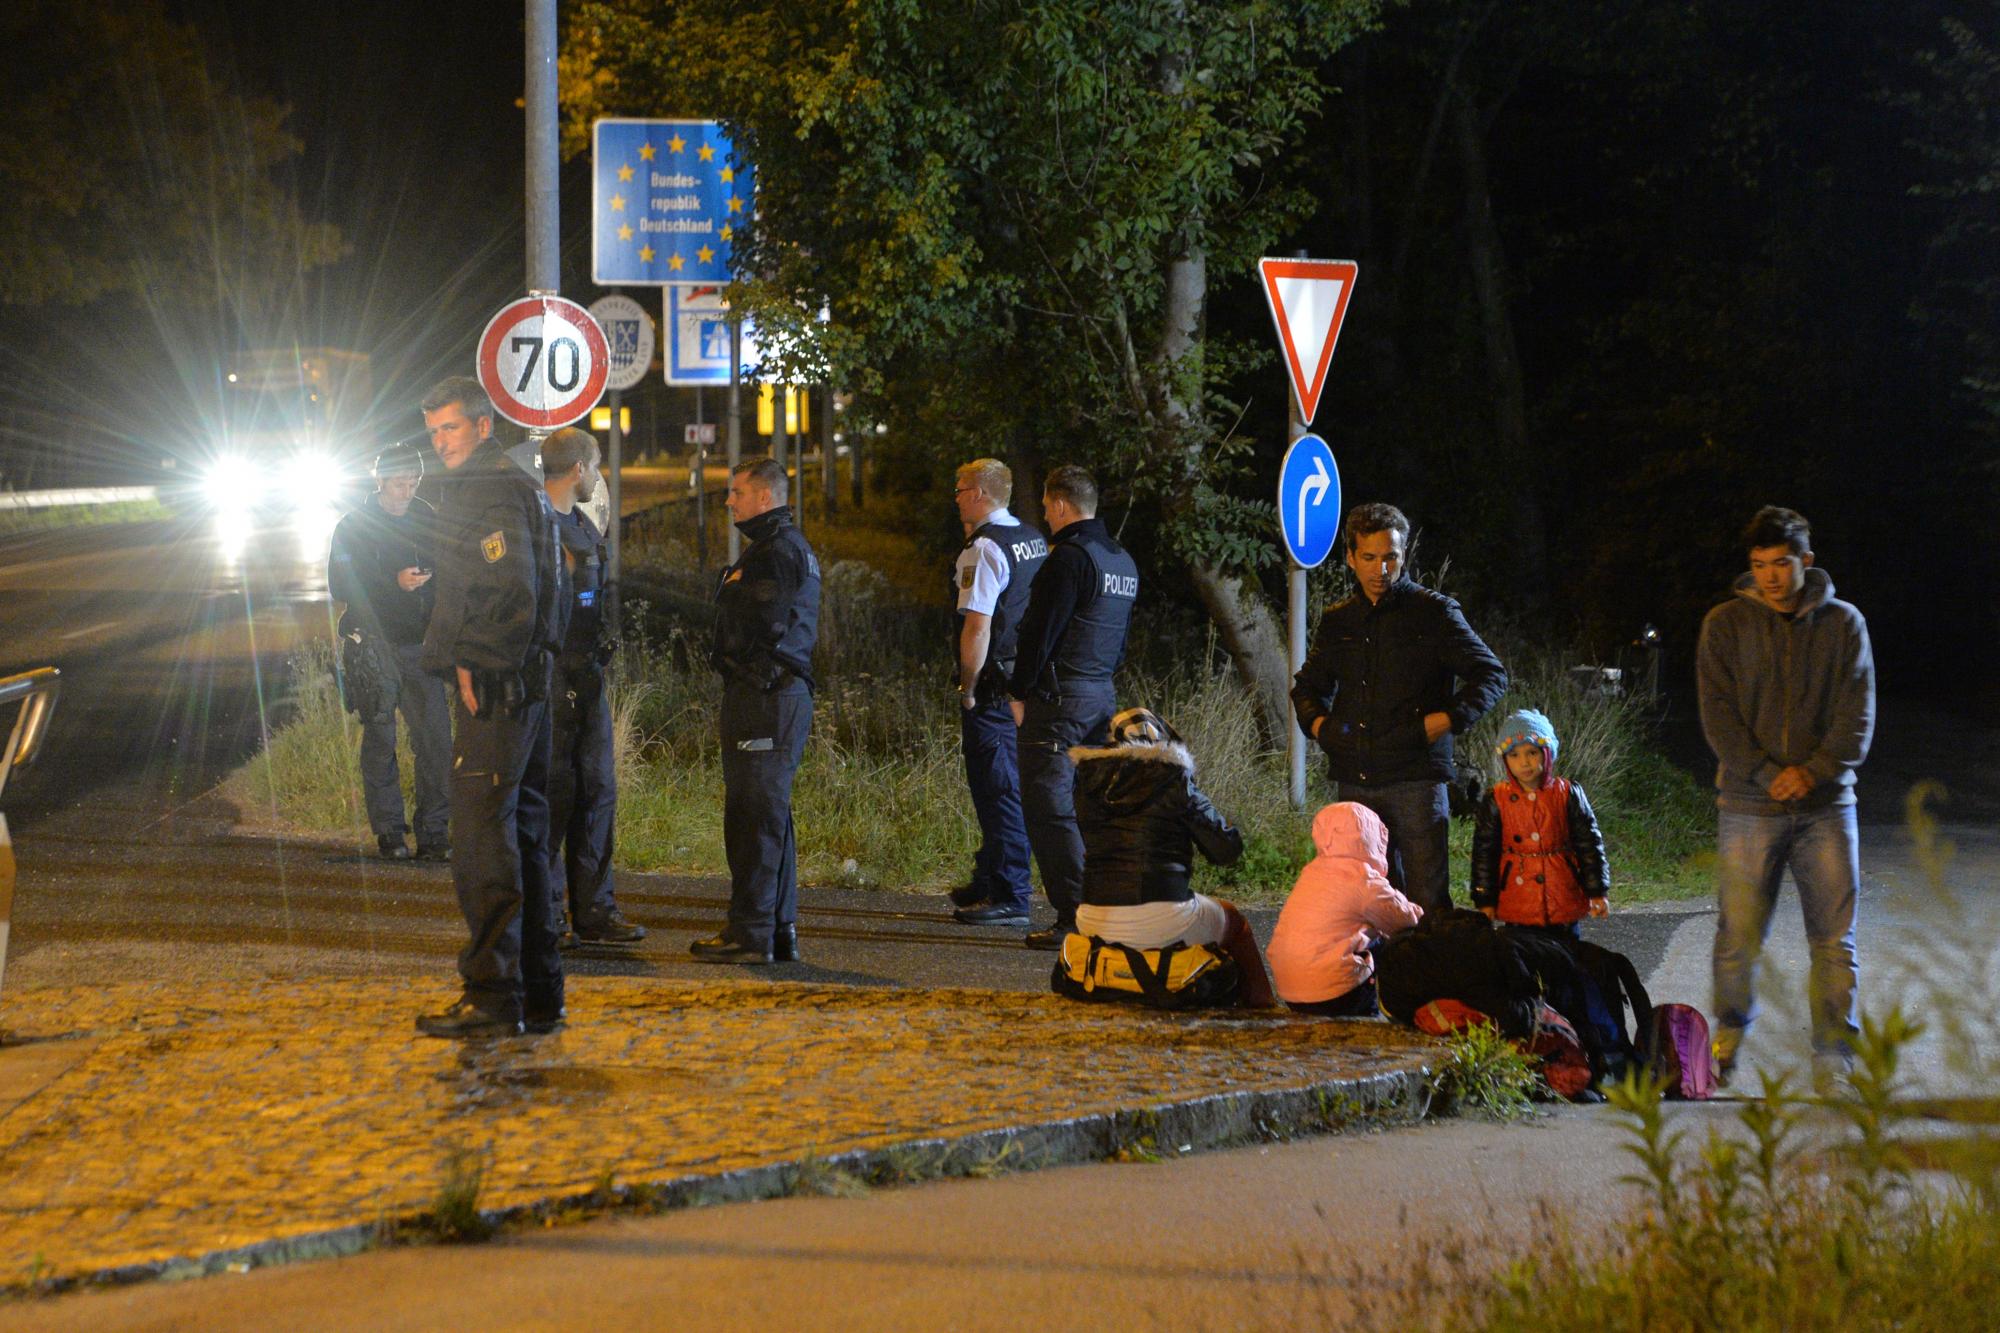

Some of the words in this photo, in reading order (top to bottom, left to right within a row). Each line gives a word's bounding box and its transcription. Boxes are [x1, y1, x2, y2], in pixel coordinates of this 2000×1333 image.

[652, 171, 702, 188] Bundes-
[652, 195, 701, 213] republik
[640, 217, 713, 233] Deutschland
[511, 337, 580, 393] 70
[1104, 573, 1138, 598] POLIZEI
